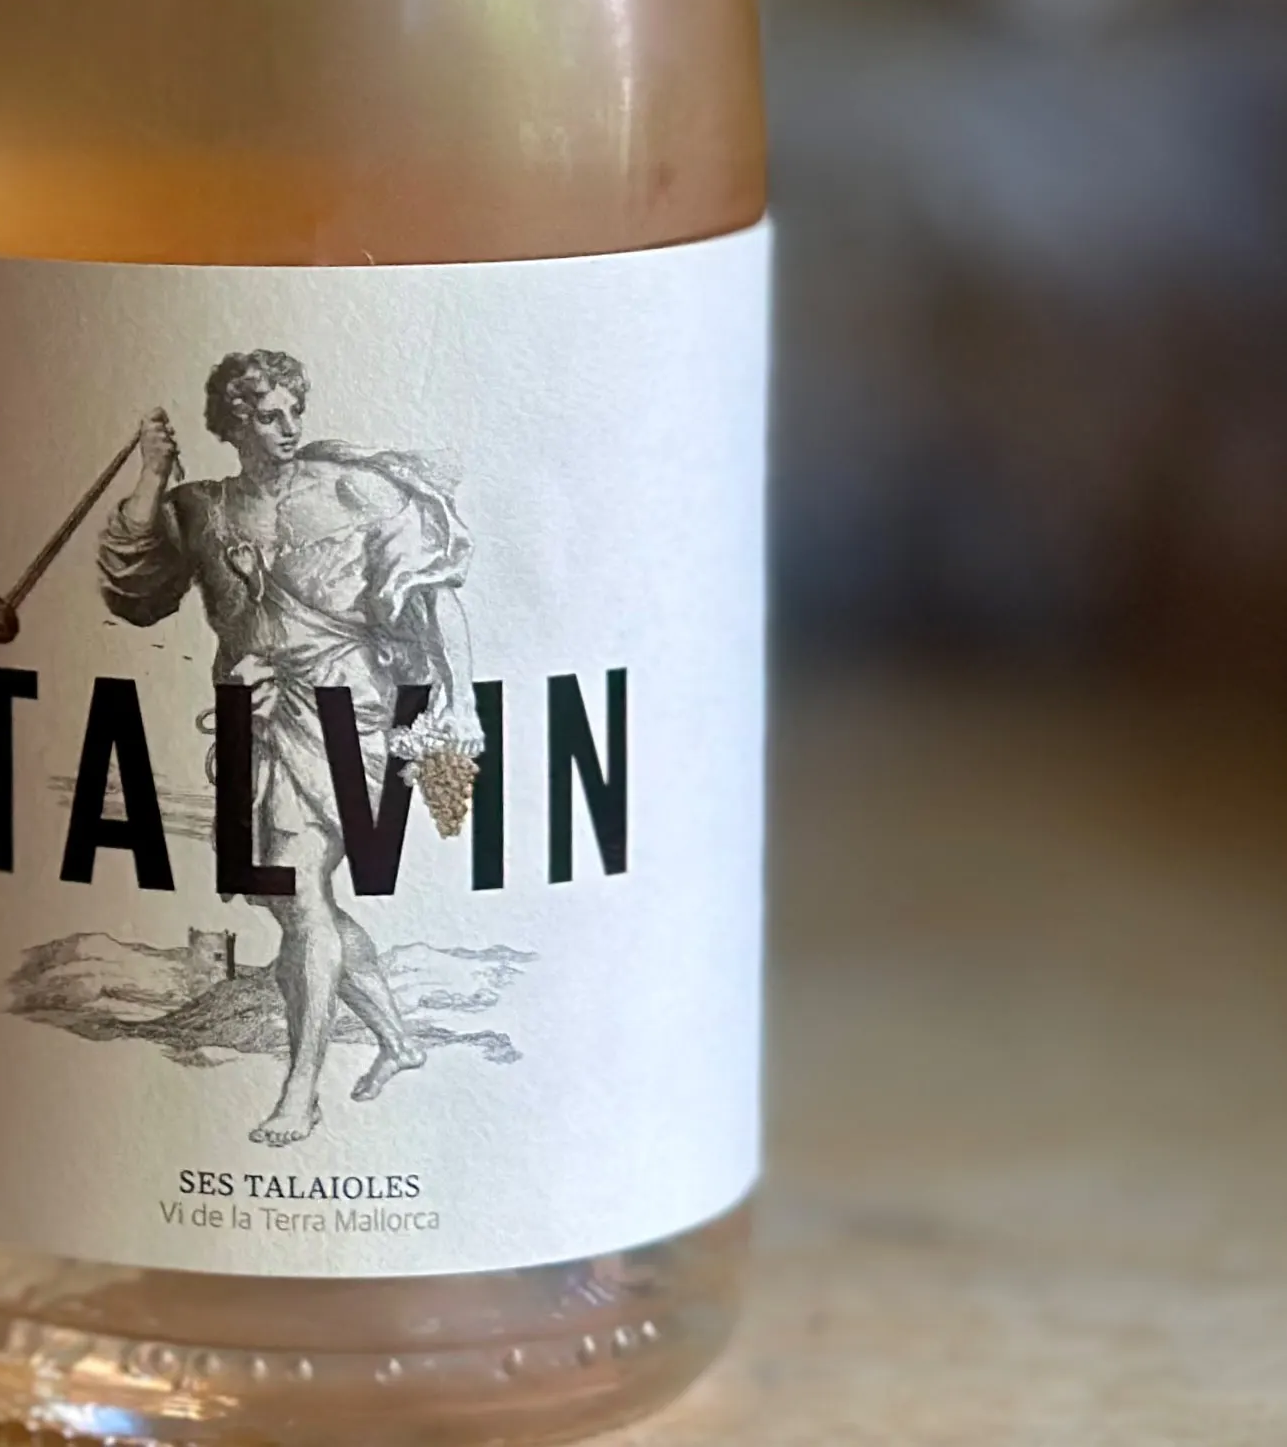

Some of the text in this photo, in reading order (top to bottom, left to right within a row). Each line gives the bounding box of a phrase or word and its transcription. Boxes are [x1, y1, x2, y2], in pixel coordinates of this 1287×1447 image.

[179, 1169, 420, 1199] SES TALAIOLES
[159, 1200, 440, 1234] Vi de la Terra Mallorca
